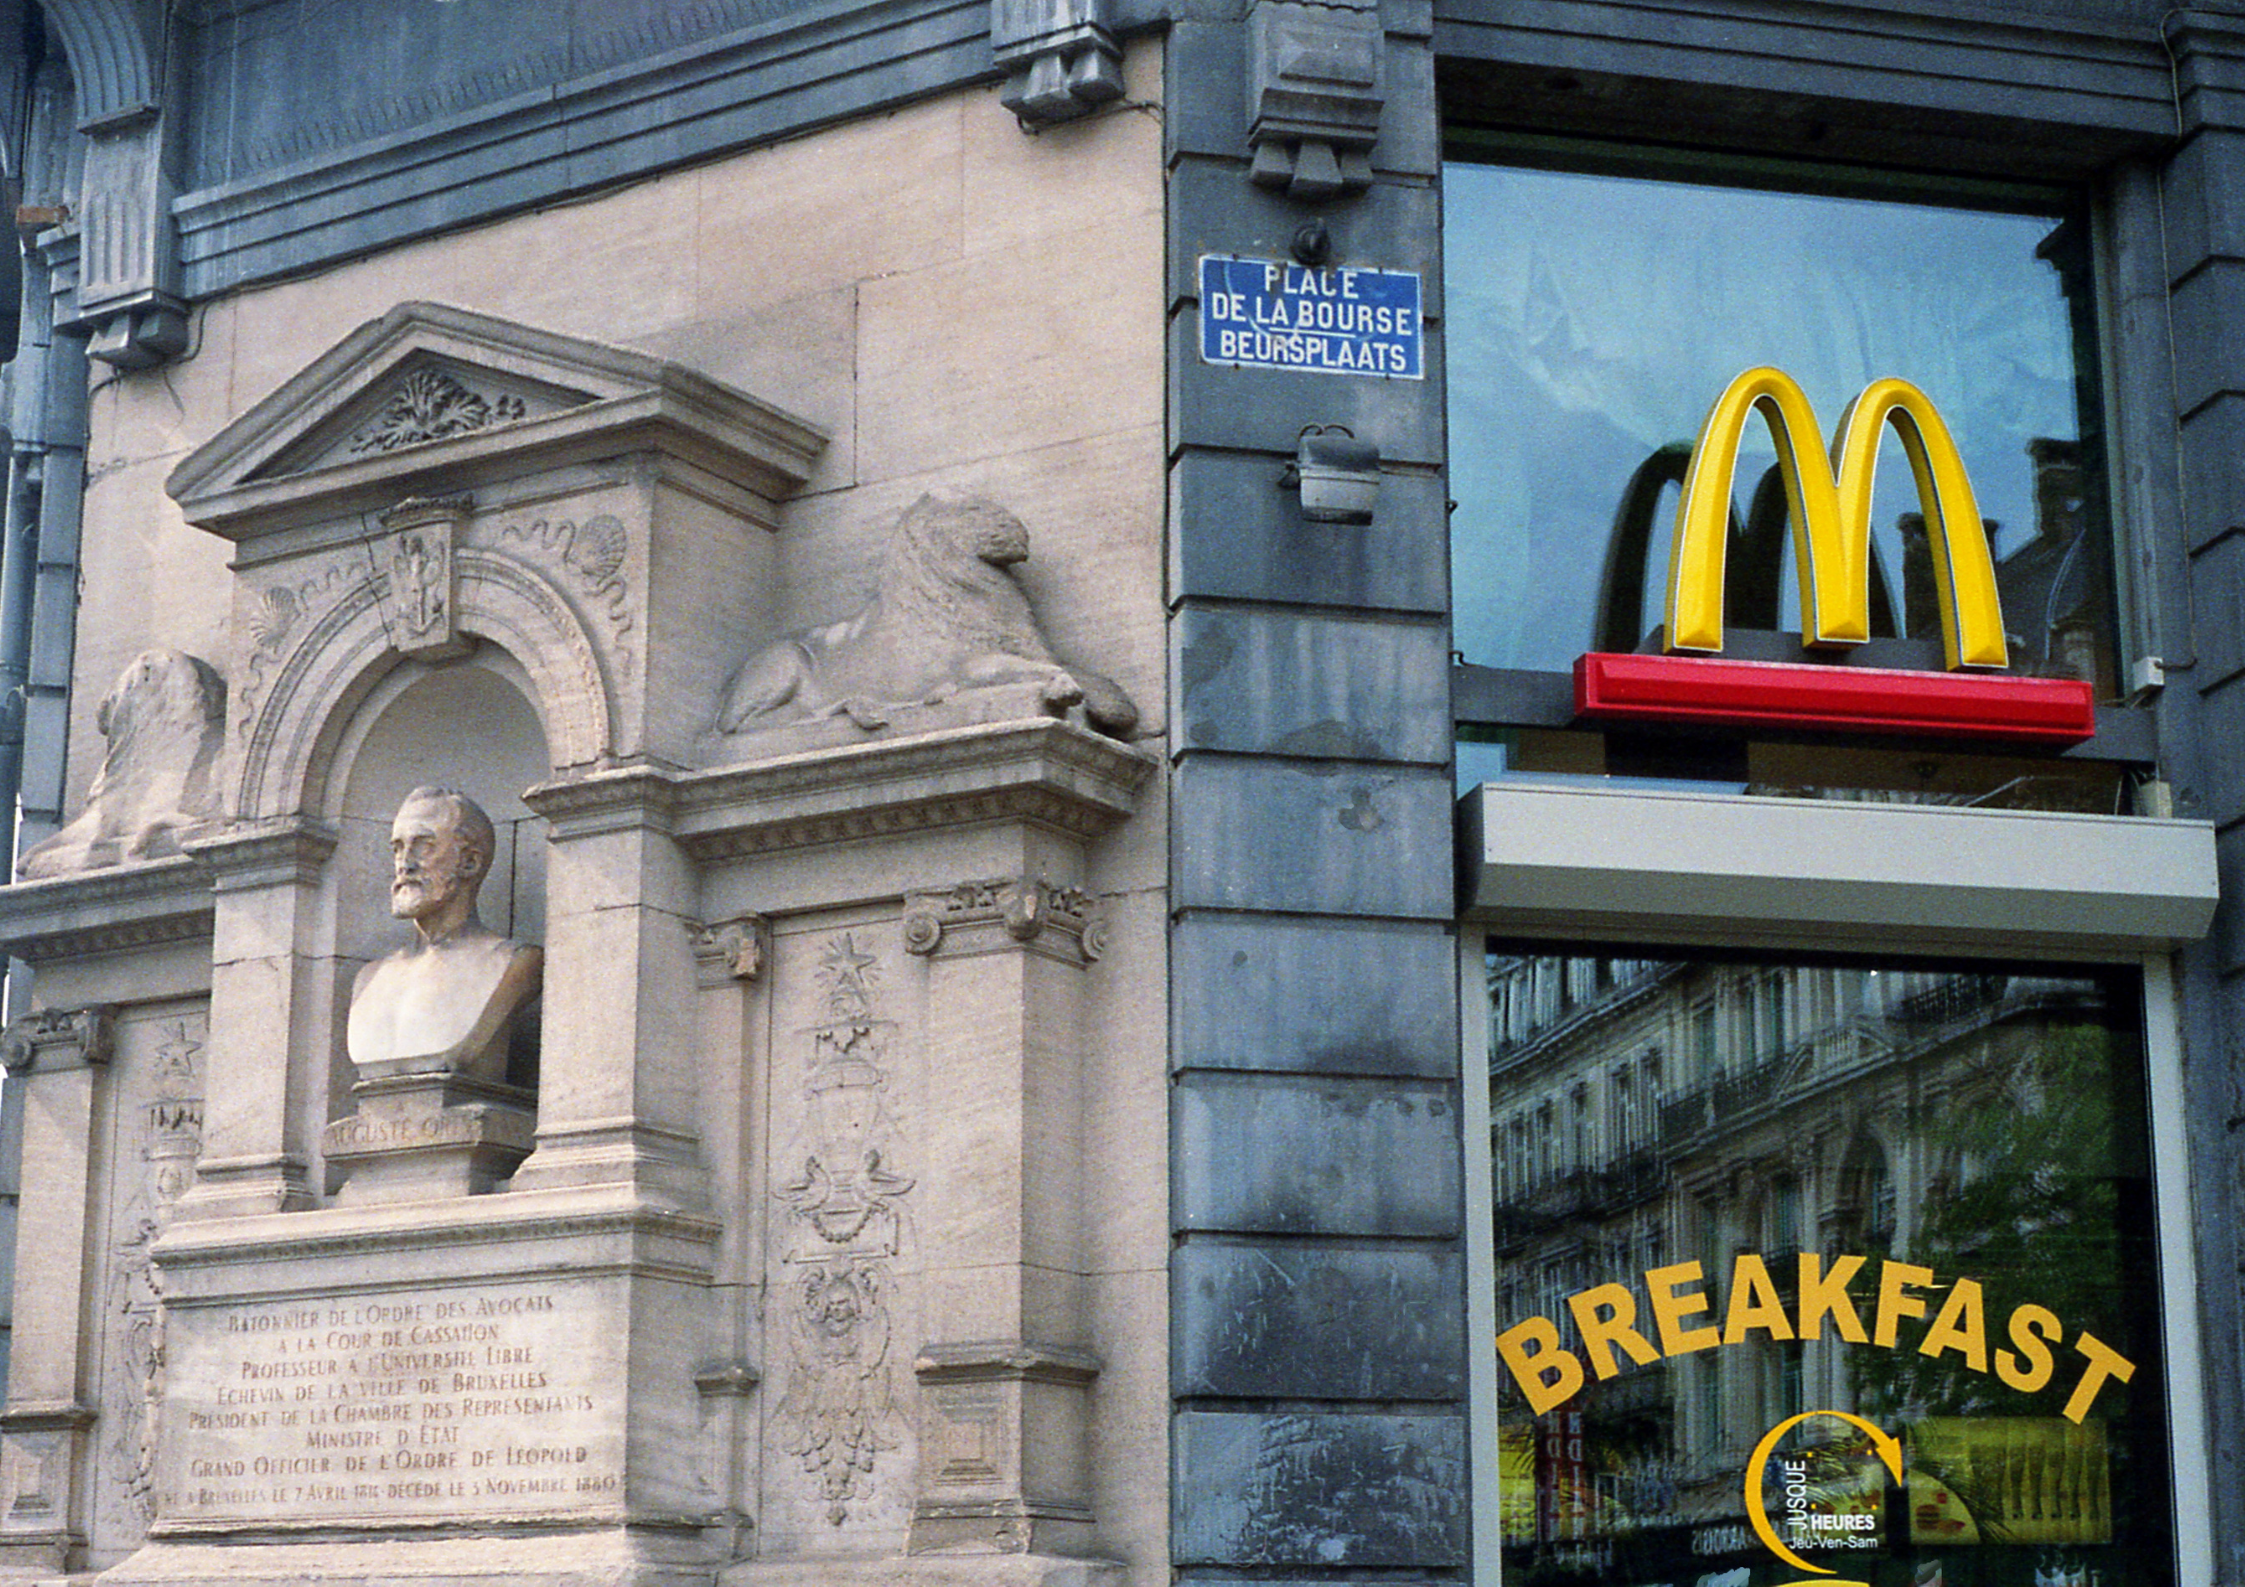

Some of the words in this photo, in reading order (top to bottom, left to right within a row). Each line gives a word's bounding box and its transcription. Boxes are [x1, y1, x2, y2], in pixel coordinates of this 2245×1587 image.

[1265, 264, 1359, 299] PLACE
[1212, 291, 1246, 322] DE
[1256, 296, 1289, 326] LA
[1298, 300, 1413, 336] BOURSE
[1220, 330, 1407, 372] BEURSPLAATS
[329, 1309, 347, 1326] DE
[436, 1301, 466, 1319] DES
[476, 1296, 553, 1316] AVOCATS
[326, 1331, 372, 1350] COUR
[382, 1331, 402, 1347] DE
[411, 1323, 499, 1345] CASSATION
[1495, 1252, 2137, 1425] BREAKFAST
[242, 1361, 338, 1380] PROFESSEUR
[487, 1346, 533, 1366] LIBRE
[296, 1385, 314, 1401] DE
[328, 1383, 349, 1399] LA
[419, 1378, 440, 1394] DE
[453, 1372, 547, 1393] BRUXELLES
[281, 1410, 300, 1426] DE
[310, 1409, 327, 1425] LA
[334, 1403, 411, 1423] CHAMBRE
[423, 1402, 453, 1419] DES
[306, 1430, 381, 1449] MINISTRE
[191, 1458, 246, 1478] GRAND
[254, 1456, 330, 1476] OFFICIER
[346, 1456, 366, 1471] DE
[472, 1450, 494, 1467] DE
[272, 1488, 287, 1503] LE
[306, 1484, 347, 1500] AVRIL
[450, 1482, 464, 1497] LE
[1785, 1460, 1807, 1530] JUSQUE
[1811, 1514, 1876, 1530] HEURES
[1789, 1535, 1878, 1550] Jeu-Ven-Sam
